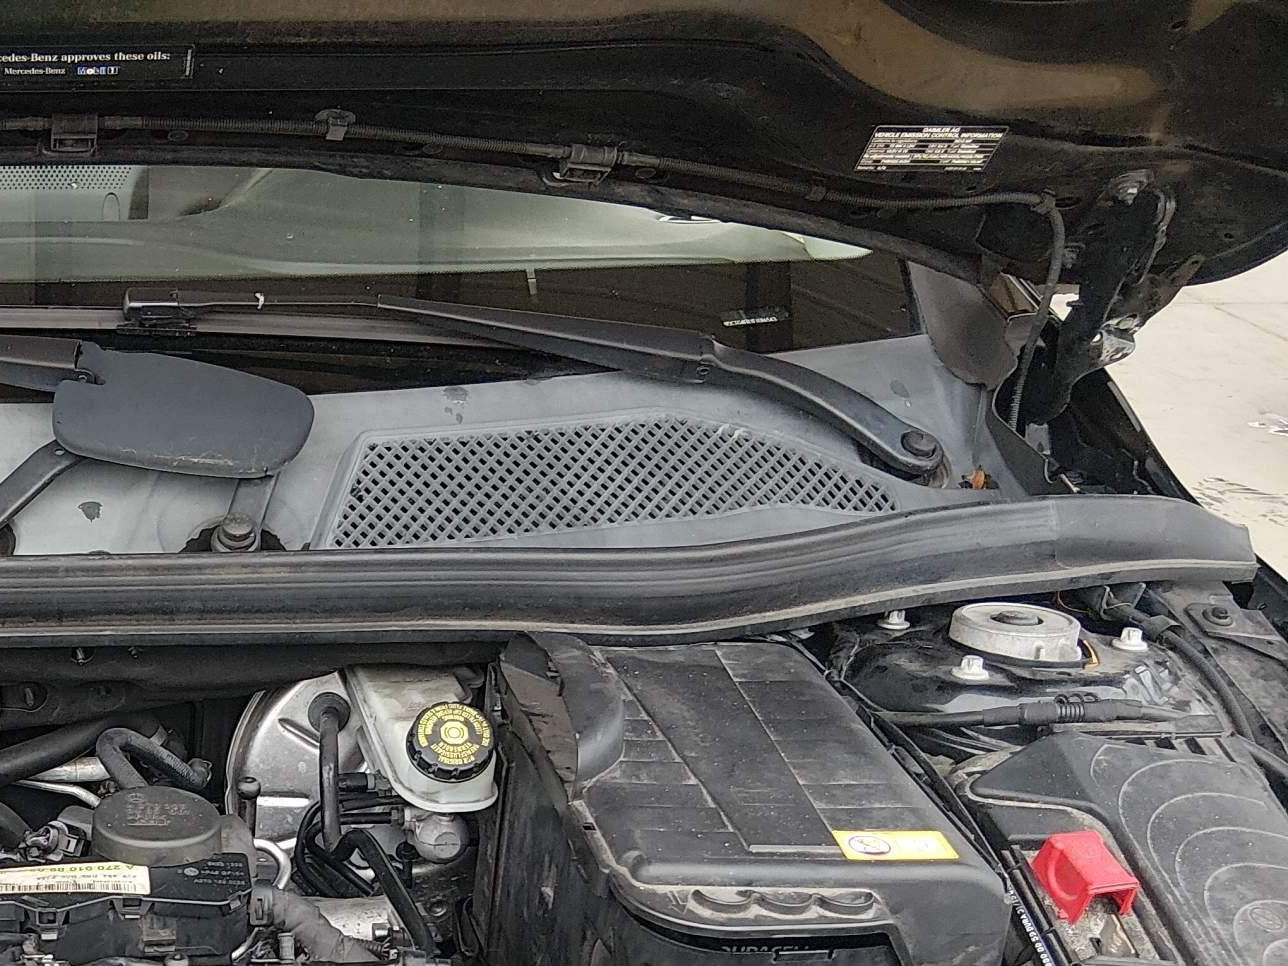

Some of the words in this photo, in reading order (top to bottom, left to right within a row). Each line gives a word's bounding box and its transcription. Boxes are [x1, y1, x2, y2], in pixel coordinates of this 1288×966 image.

[61, 53, 111, 65] approves
[114, 52, 144, 61] these
[147, 52, 171, 61] oils:
[4, 67, 66, 75] Mercedes-Benz
